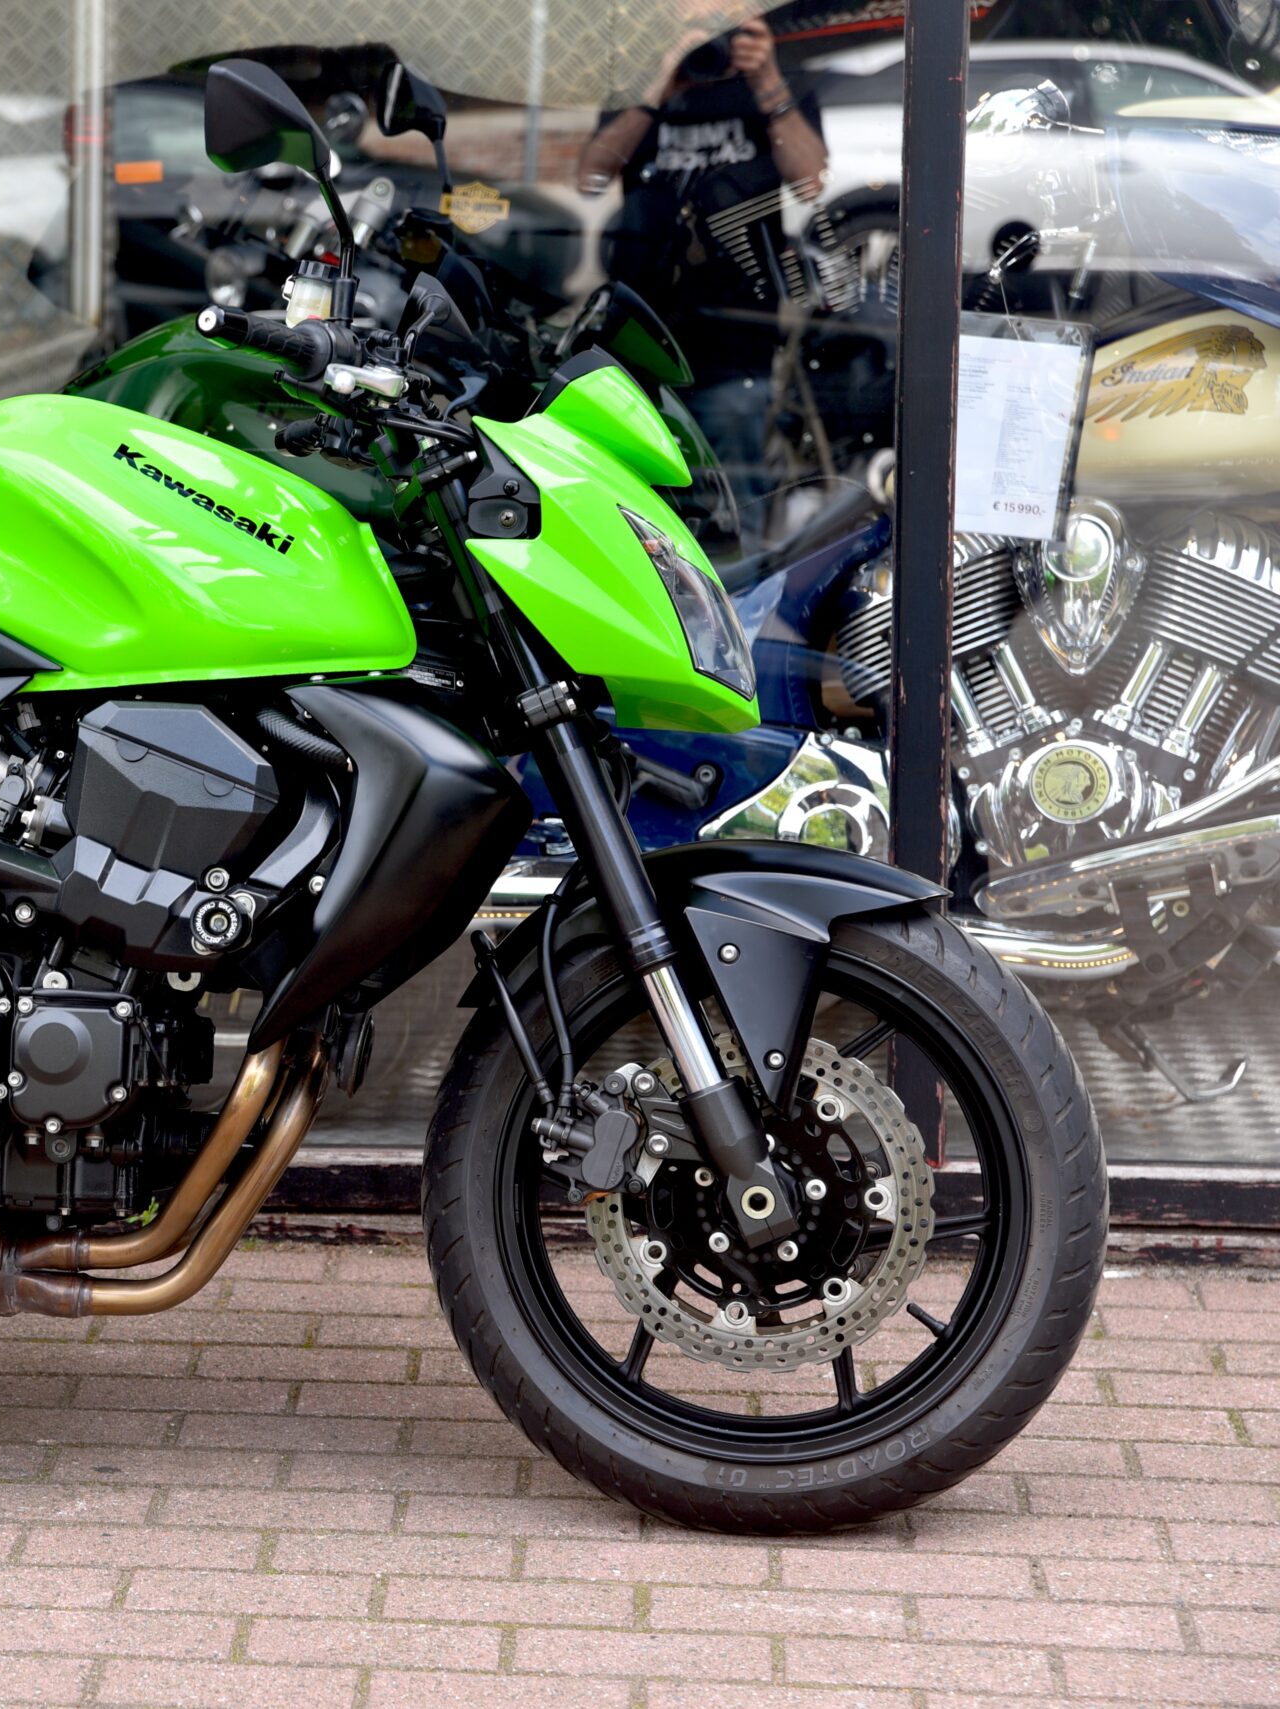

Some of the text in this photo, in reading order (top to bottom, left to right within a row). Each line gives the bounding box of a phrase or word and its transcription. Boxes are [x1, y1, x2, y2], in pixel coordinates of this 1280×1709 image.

[1100, 360, 1194, 388] Indian
[112, 442, 296, 555] Kawasaki
[992, 501, 1001, 511] €
[1035, 748, 1106, 804] INDIAN MOTORCYCLE
[218, 901, 238, 939] BIKE DESIGN
[886, 948, 1032, 1098] METZELER
[712, 1422, 932, 1490] ROADTEC 01
